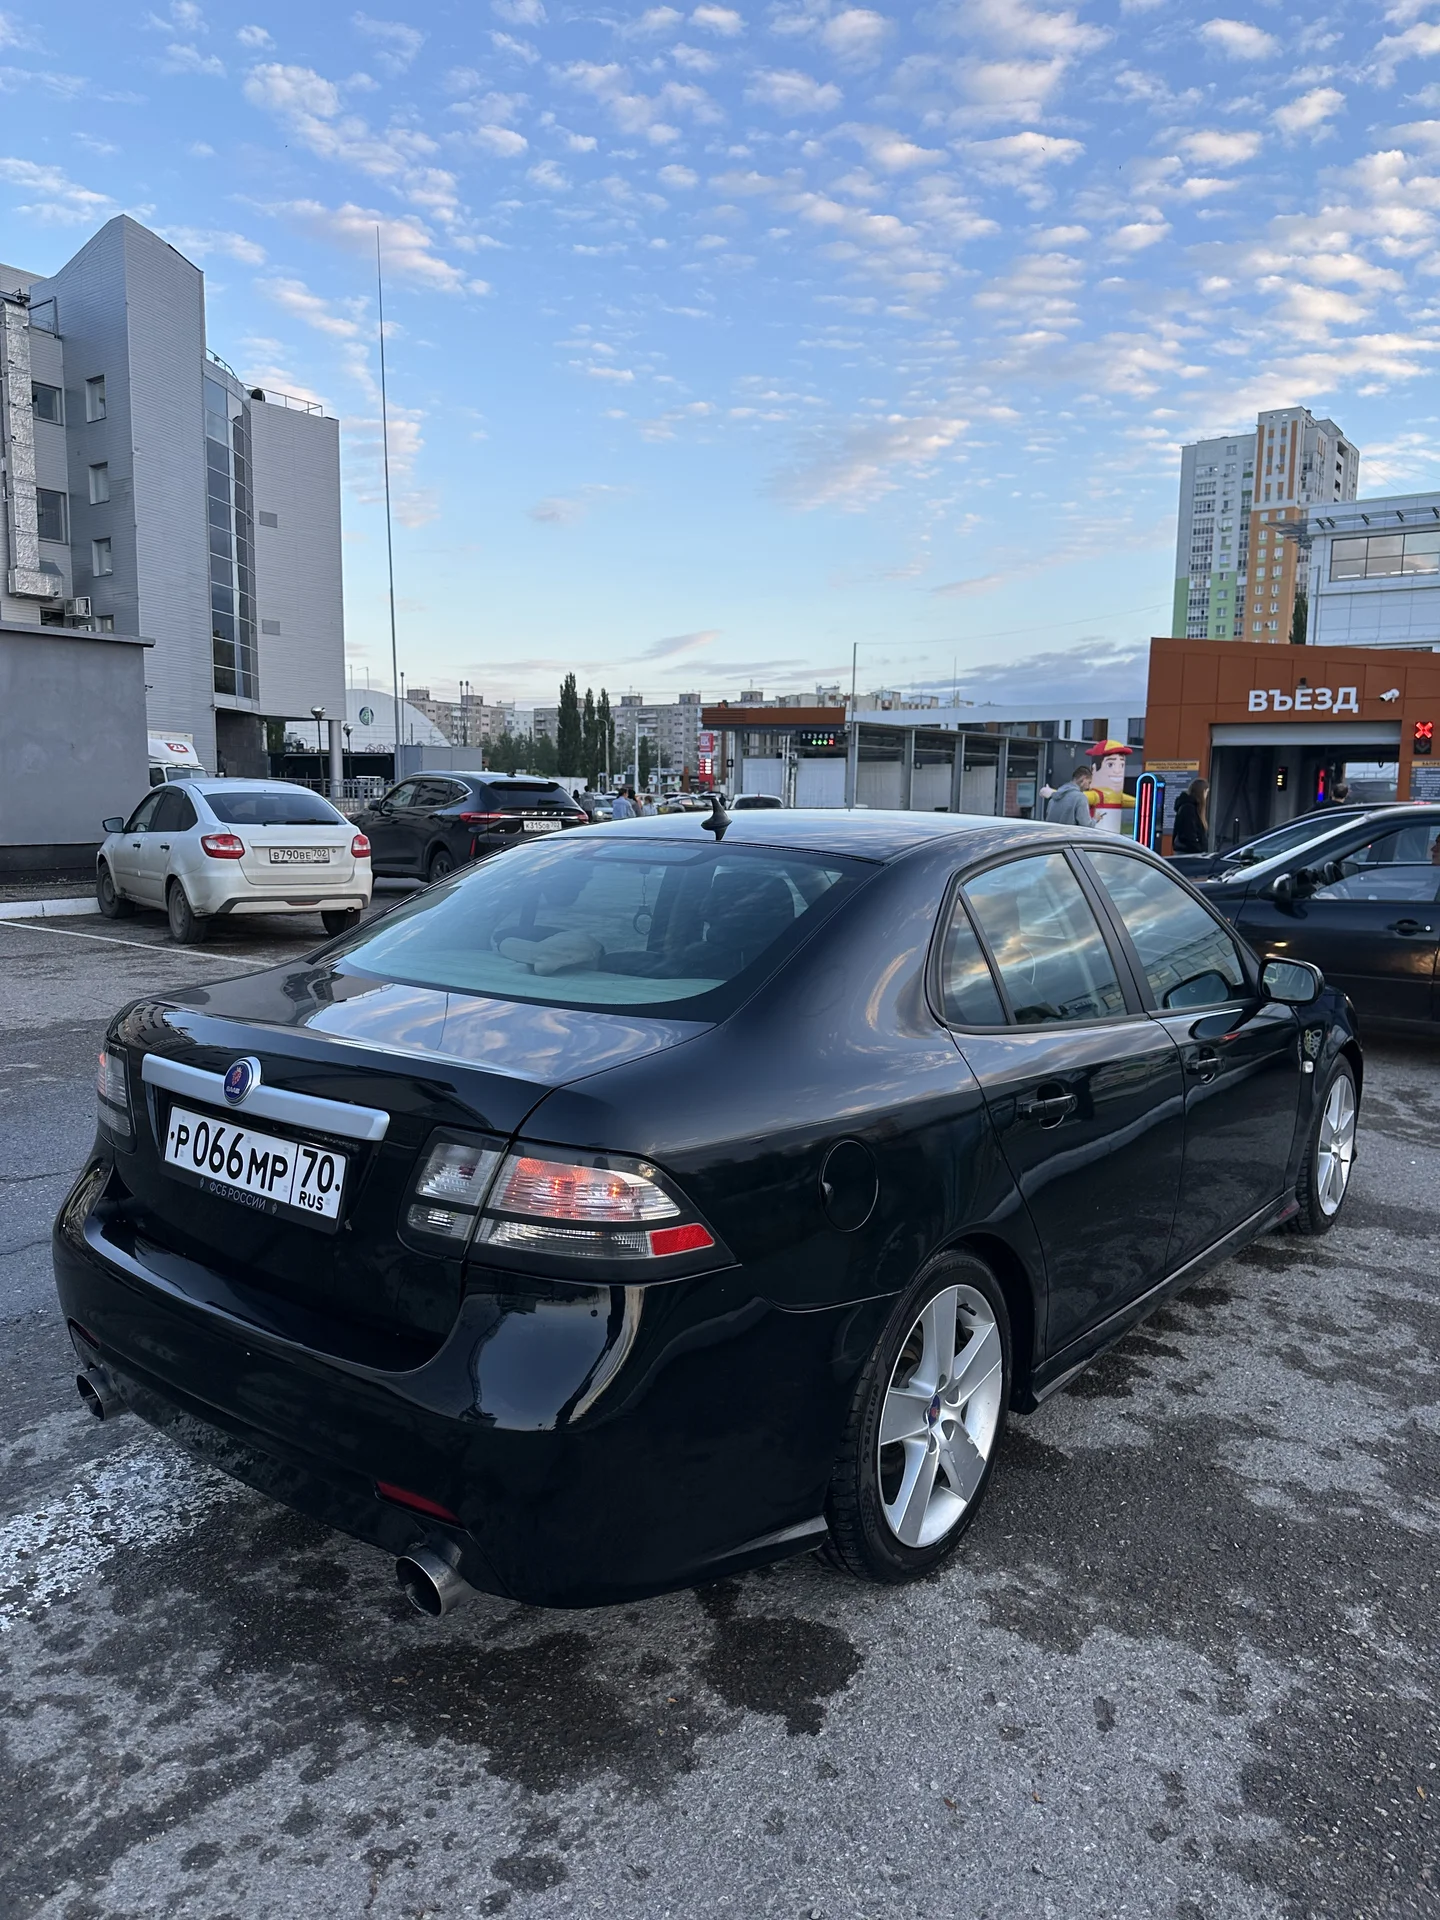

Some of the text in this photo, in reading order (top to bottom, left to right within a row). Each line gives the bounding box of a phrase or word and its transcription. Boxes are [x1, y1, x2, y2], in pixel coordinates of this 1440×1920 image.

[1248, 686, 1358, 713] ВЪЕЗД
[273, 849, 327, 860] В790ВЕ 702
[174, 1121, 335, 1194] Р066МР 70
[209, 1181, 267, 1210] ФСБ РОССИИ
[299, 1190, 324, 1211] RUS
